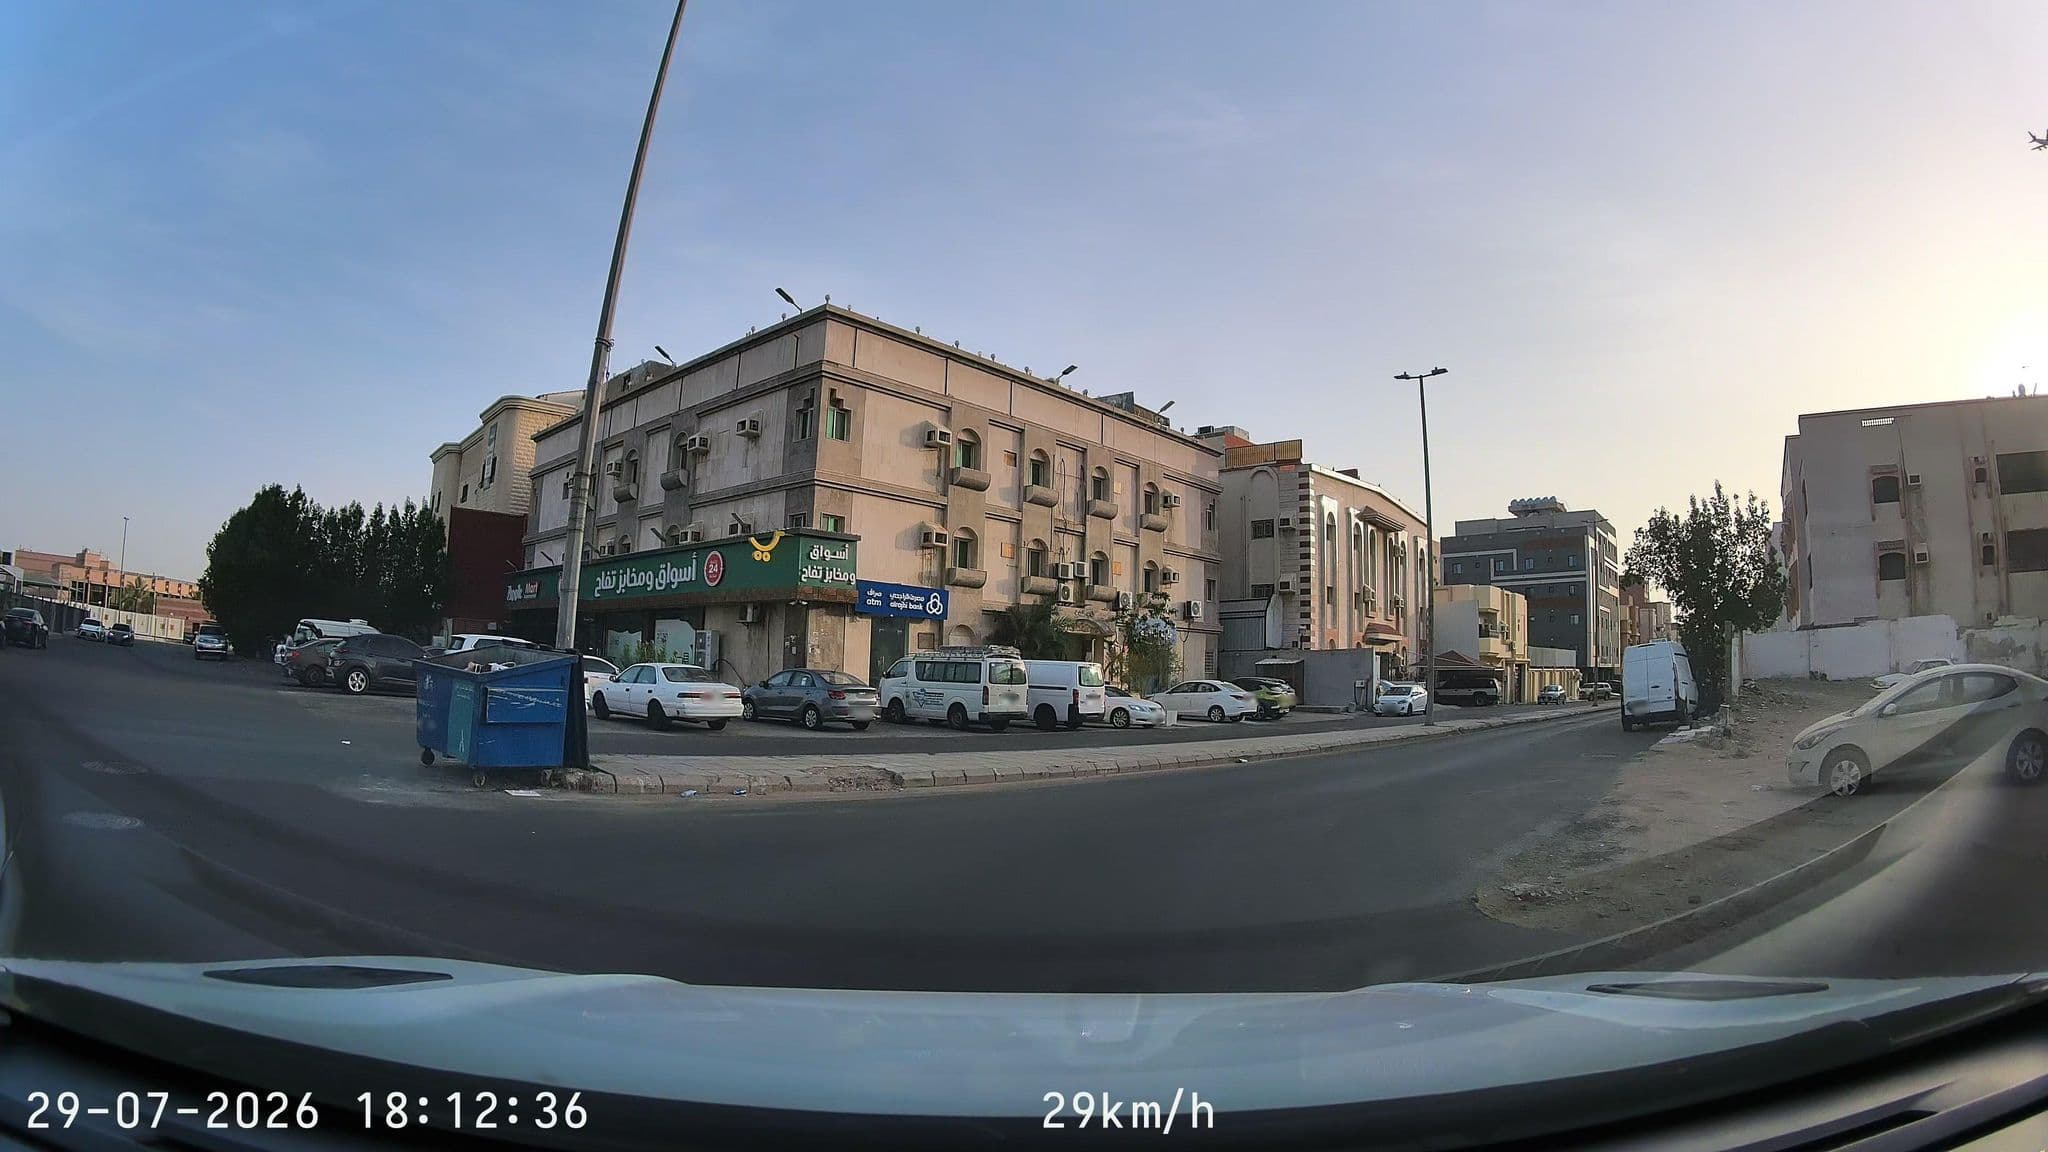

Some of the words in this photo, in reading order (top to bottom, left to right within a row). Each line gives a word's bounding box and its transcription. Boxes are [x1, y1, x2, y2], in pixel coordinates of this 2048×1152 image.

[810, 543, 849, 561] أسواق
[655, 551, 697, 591] أسواق
[708, 563, 718, 574] 24
[801, 564, 823, 582] تفاح
[823, 566, 856, 585] ومخابز
[594, 569, 617, 597] تفاح
[616, 567, 655, 594] ومخابز
[866, 598, 882, 606] atm
[909, 602, 924, 610] bank
